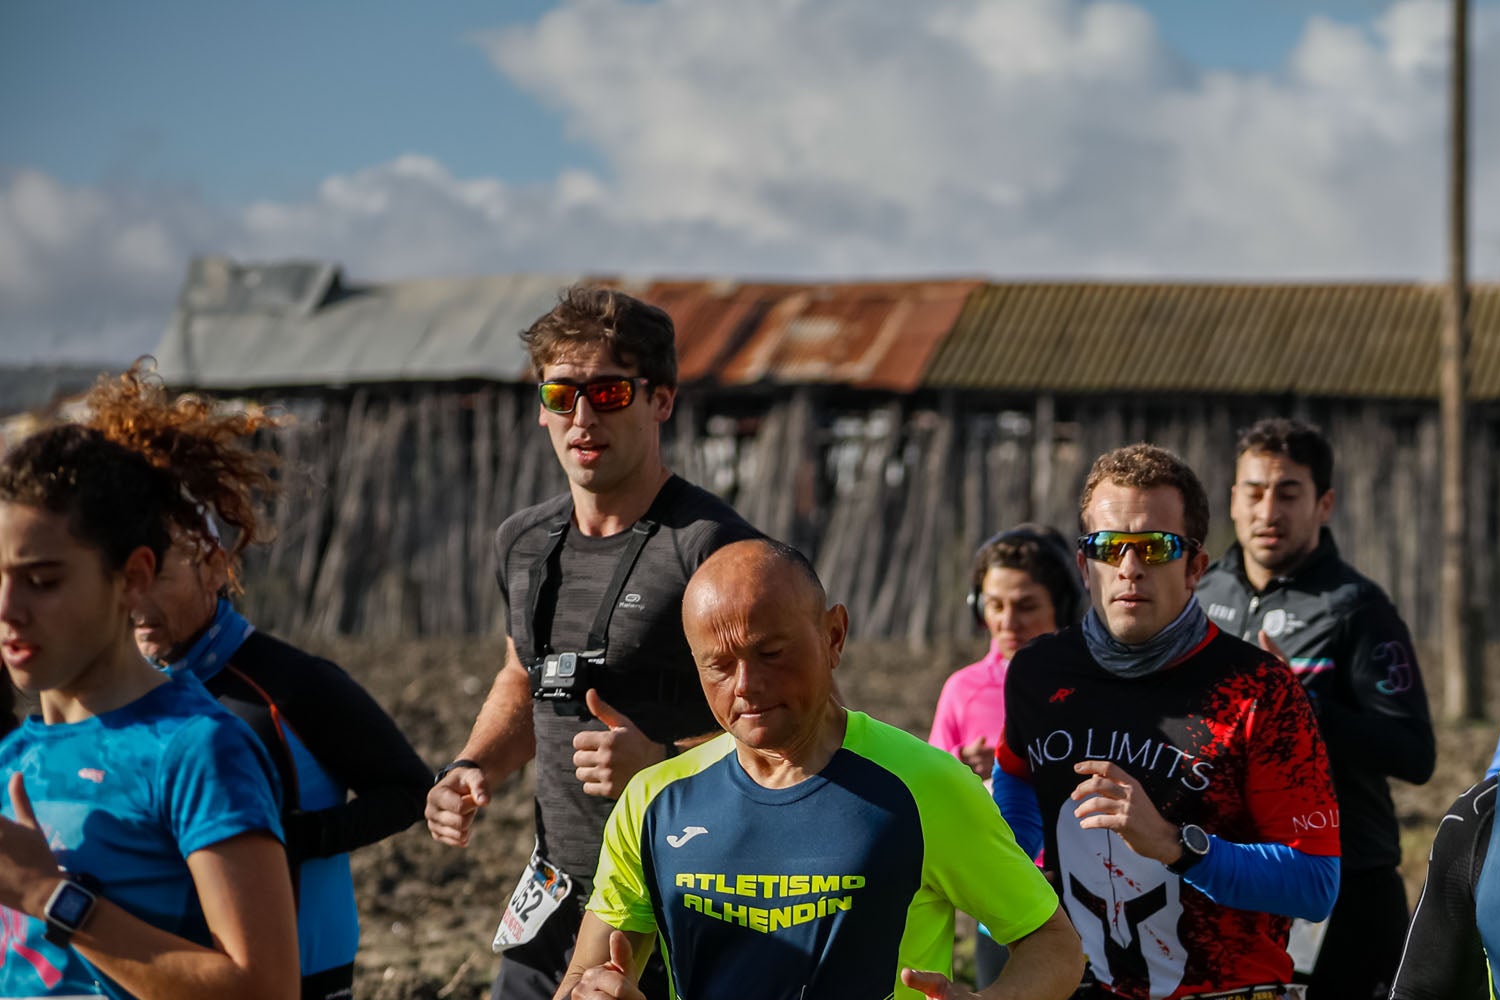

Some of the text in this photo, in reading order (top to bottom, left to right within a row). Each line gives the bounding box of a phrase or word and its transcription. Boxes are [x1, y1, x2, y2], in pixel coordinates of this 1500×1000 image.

[1028, 728, 1214, 791] NO LIMITS
[1292, 811, 1327, 833] NO
[675, 873, 866, 898] ATLETISMO
[684, 894, 853, 934] ALHENDÍN
